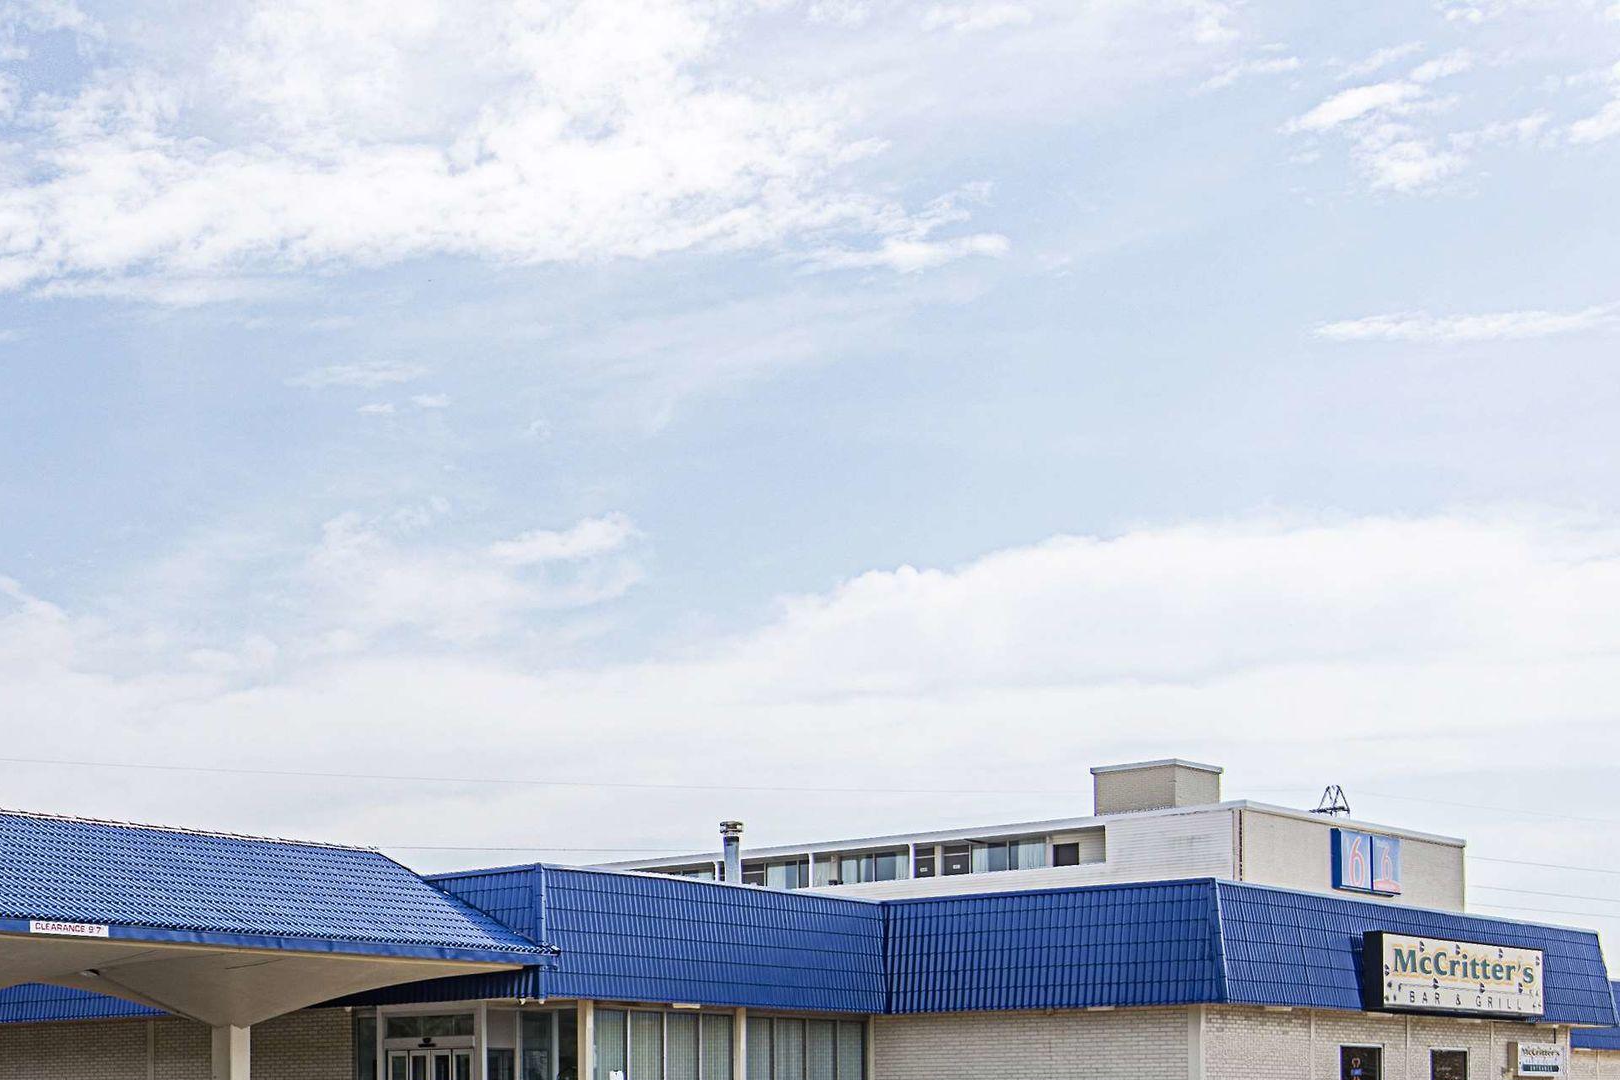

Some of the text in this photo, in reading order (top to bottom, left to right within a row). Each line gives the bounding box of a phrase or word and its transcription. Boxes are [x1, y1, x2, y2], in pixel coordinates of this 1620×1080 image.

[35, 922, 85, 933] CLEARANCE
[1393, 948, 1535, 984] McCritter's
[1409, 990, 1522, 1011] BAR & GRILL
